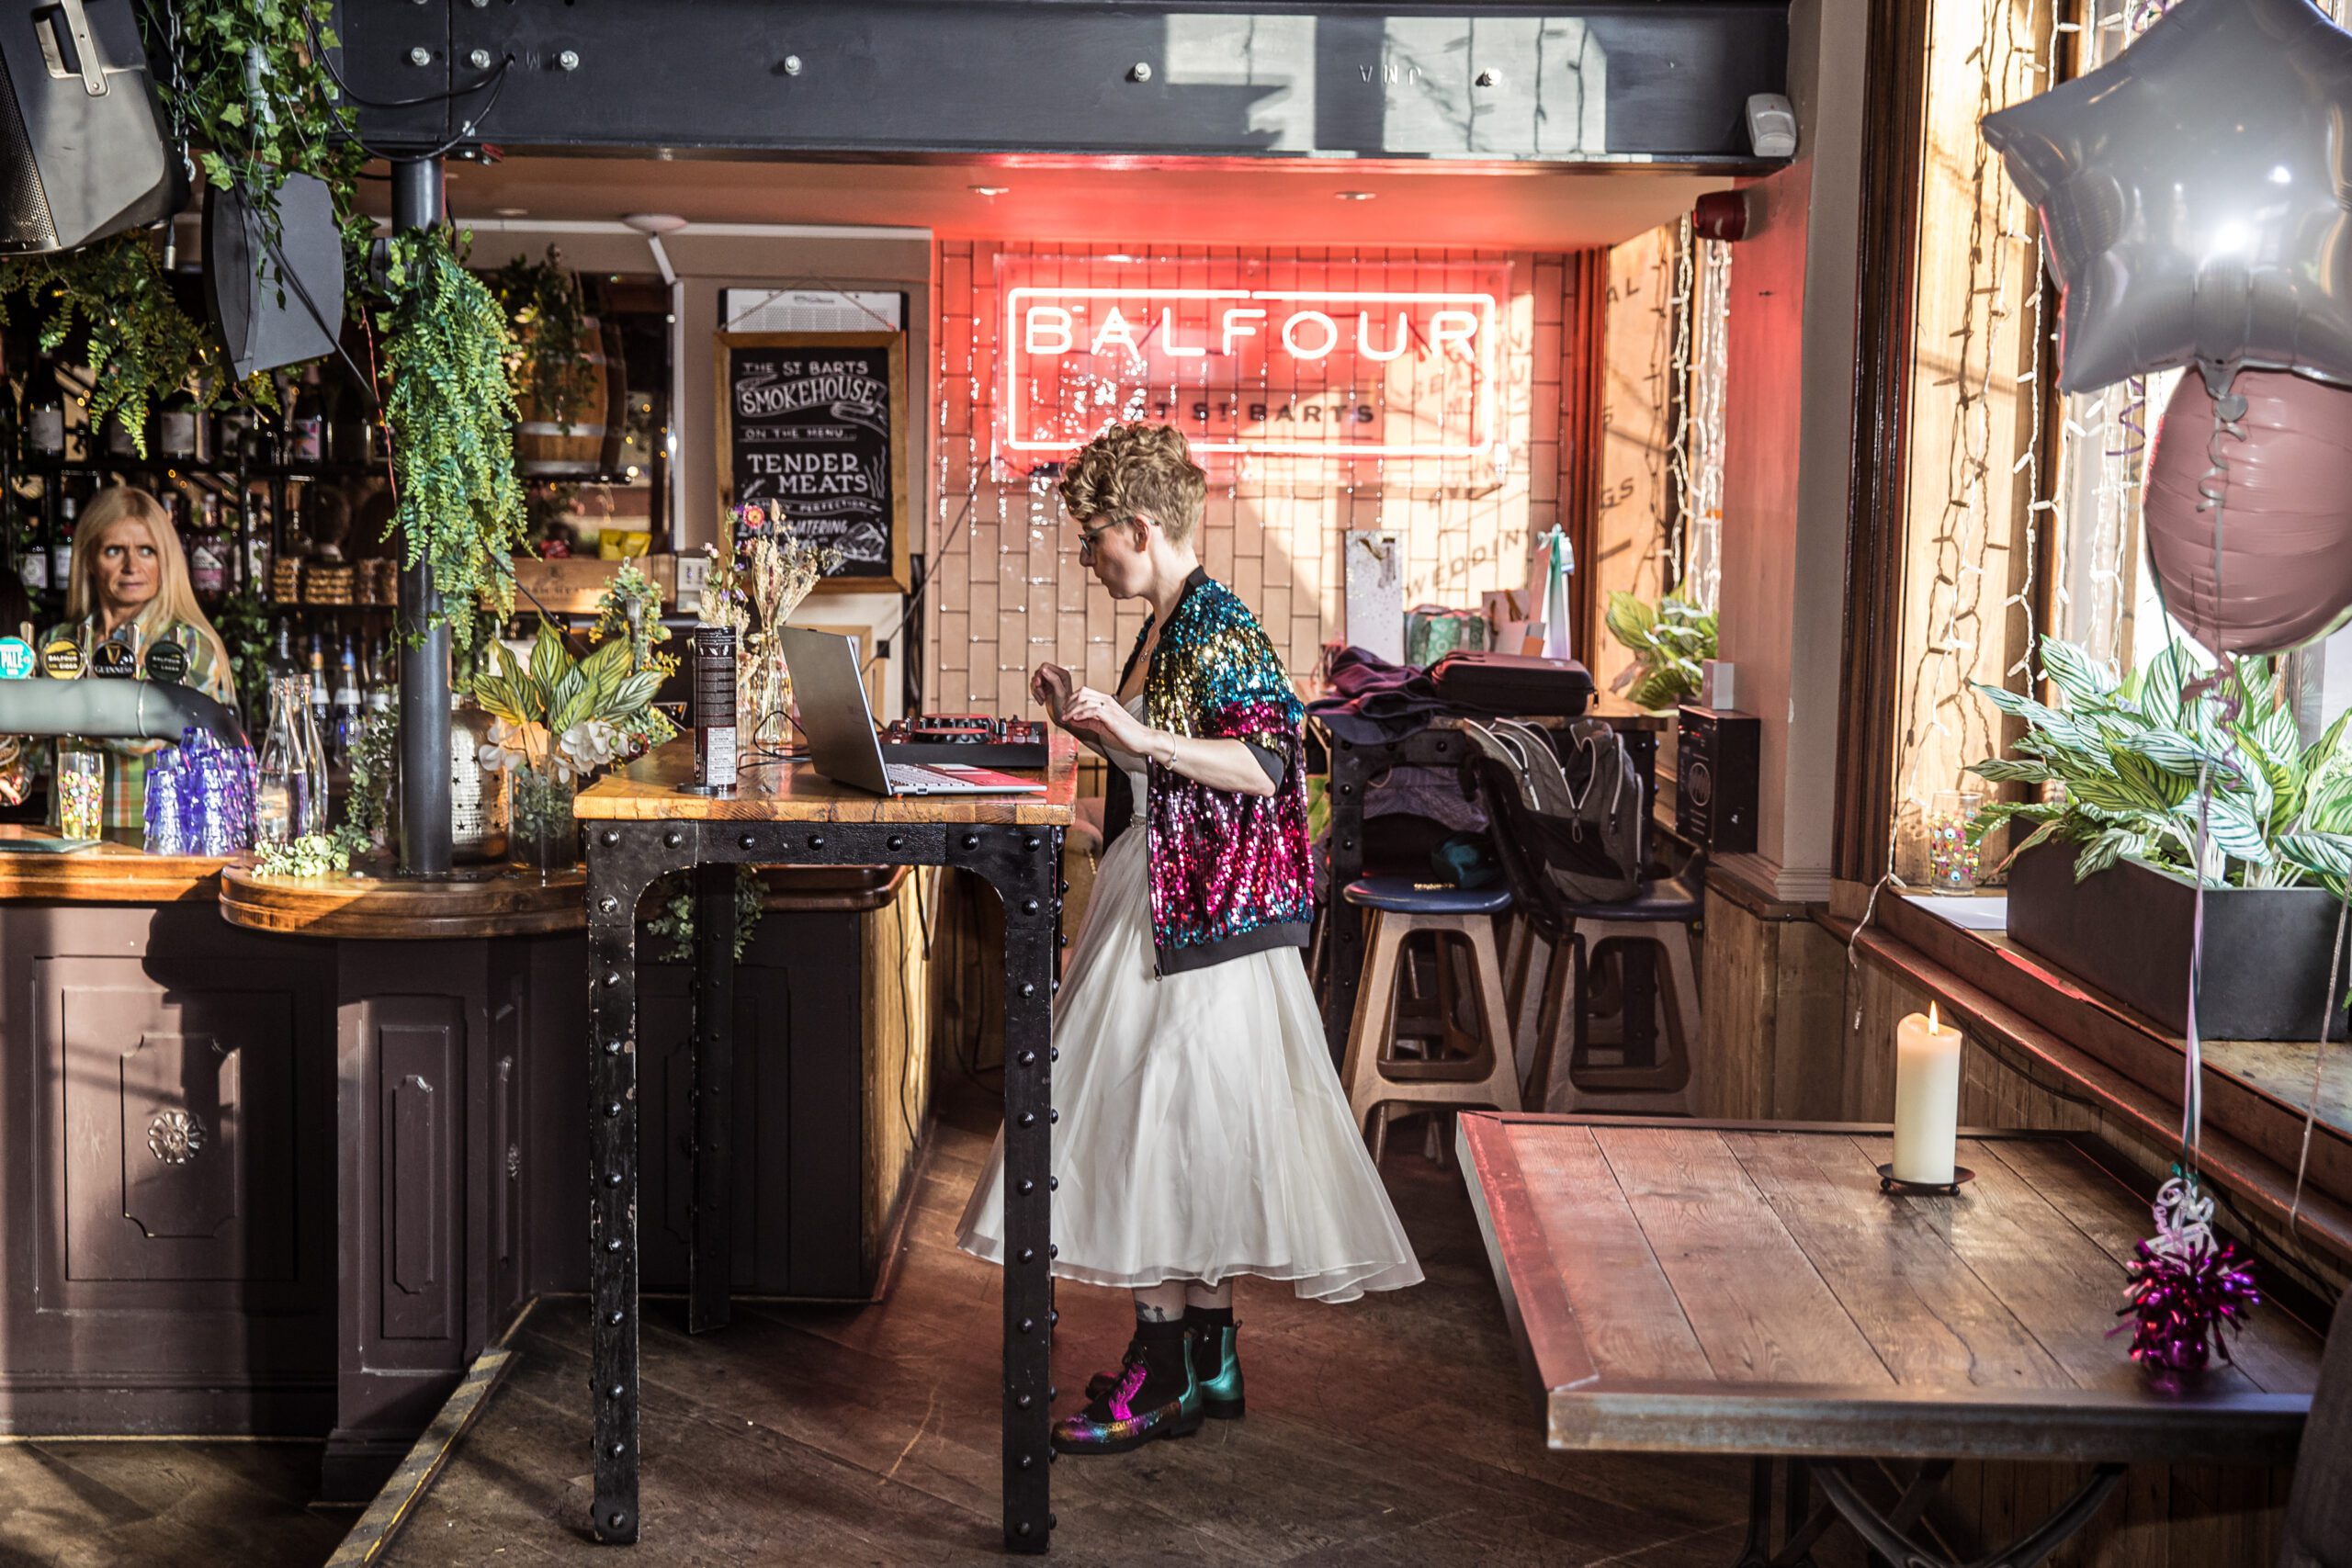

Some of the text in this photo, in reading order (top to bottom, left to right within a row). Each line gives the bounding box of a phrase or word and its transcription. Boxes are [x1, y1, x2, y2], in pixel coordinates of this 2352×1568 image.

[1025, 306, 1478, 361] BALFOUR
[742, 360, 868, 377] THE ST BARTS
[741, 376, 877, 414] SMOKEHOUSE
[1250, 402, 1374, 423] BARTS
[745, 428, 766, 440] ON
[775, 428, 798, 440] THE
[747, 452, 859, 474] TENDER
[777, 473, 868, 494] MEATS
[799, 498, 868, 513] PERFECTION
[95, 664, 133, 673] GUINNESS
